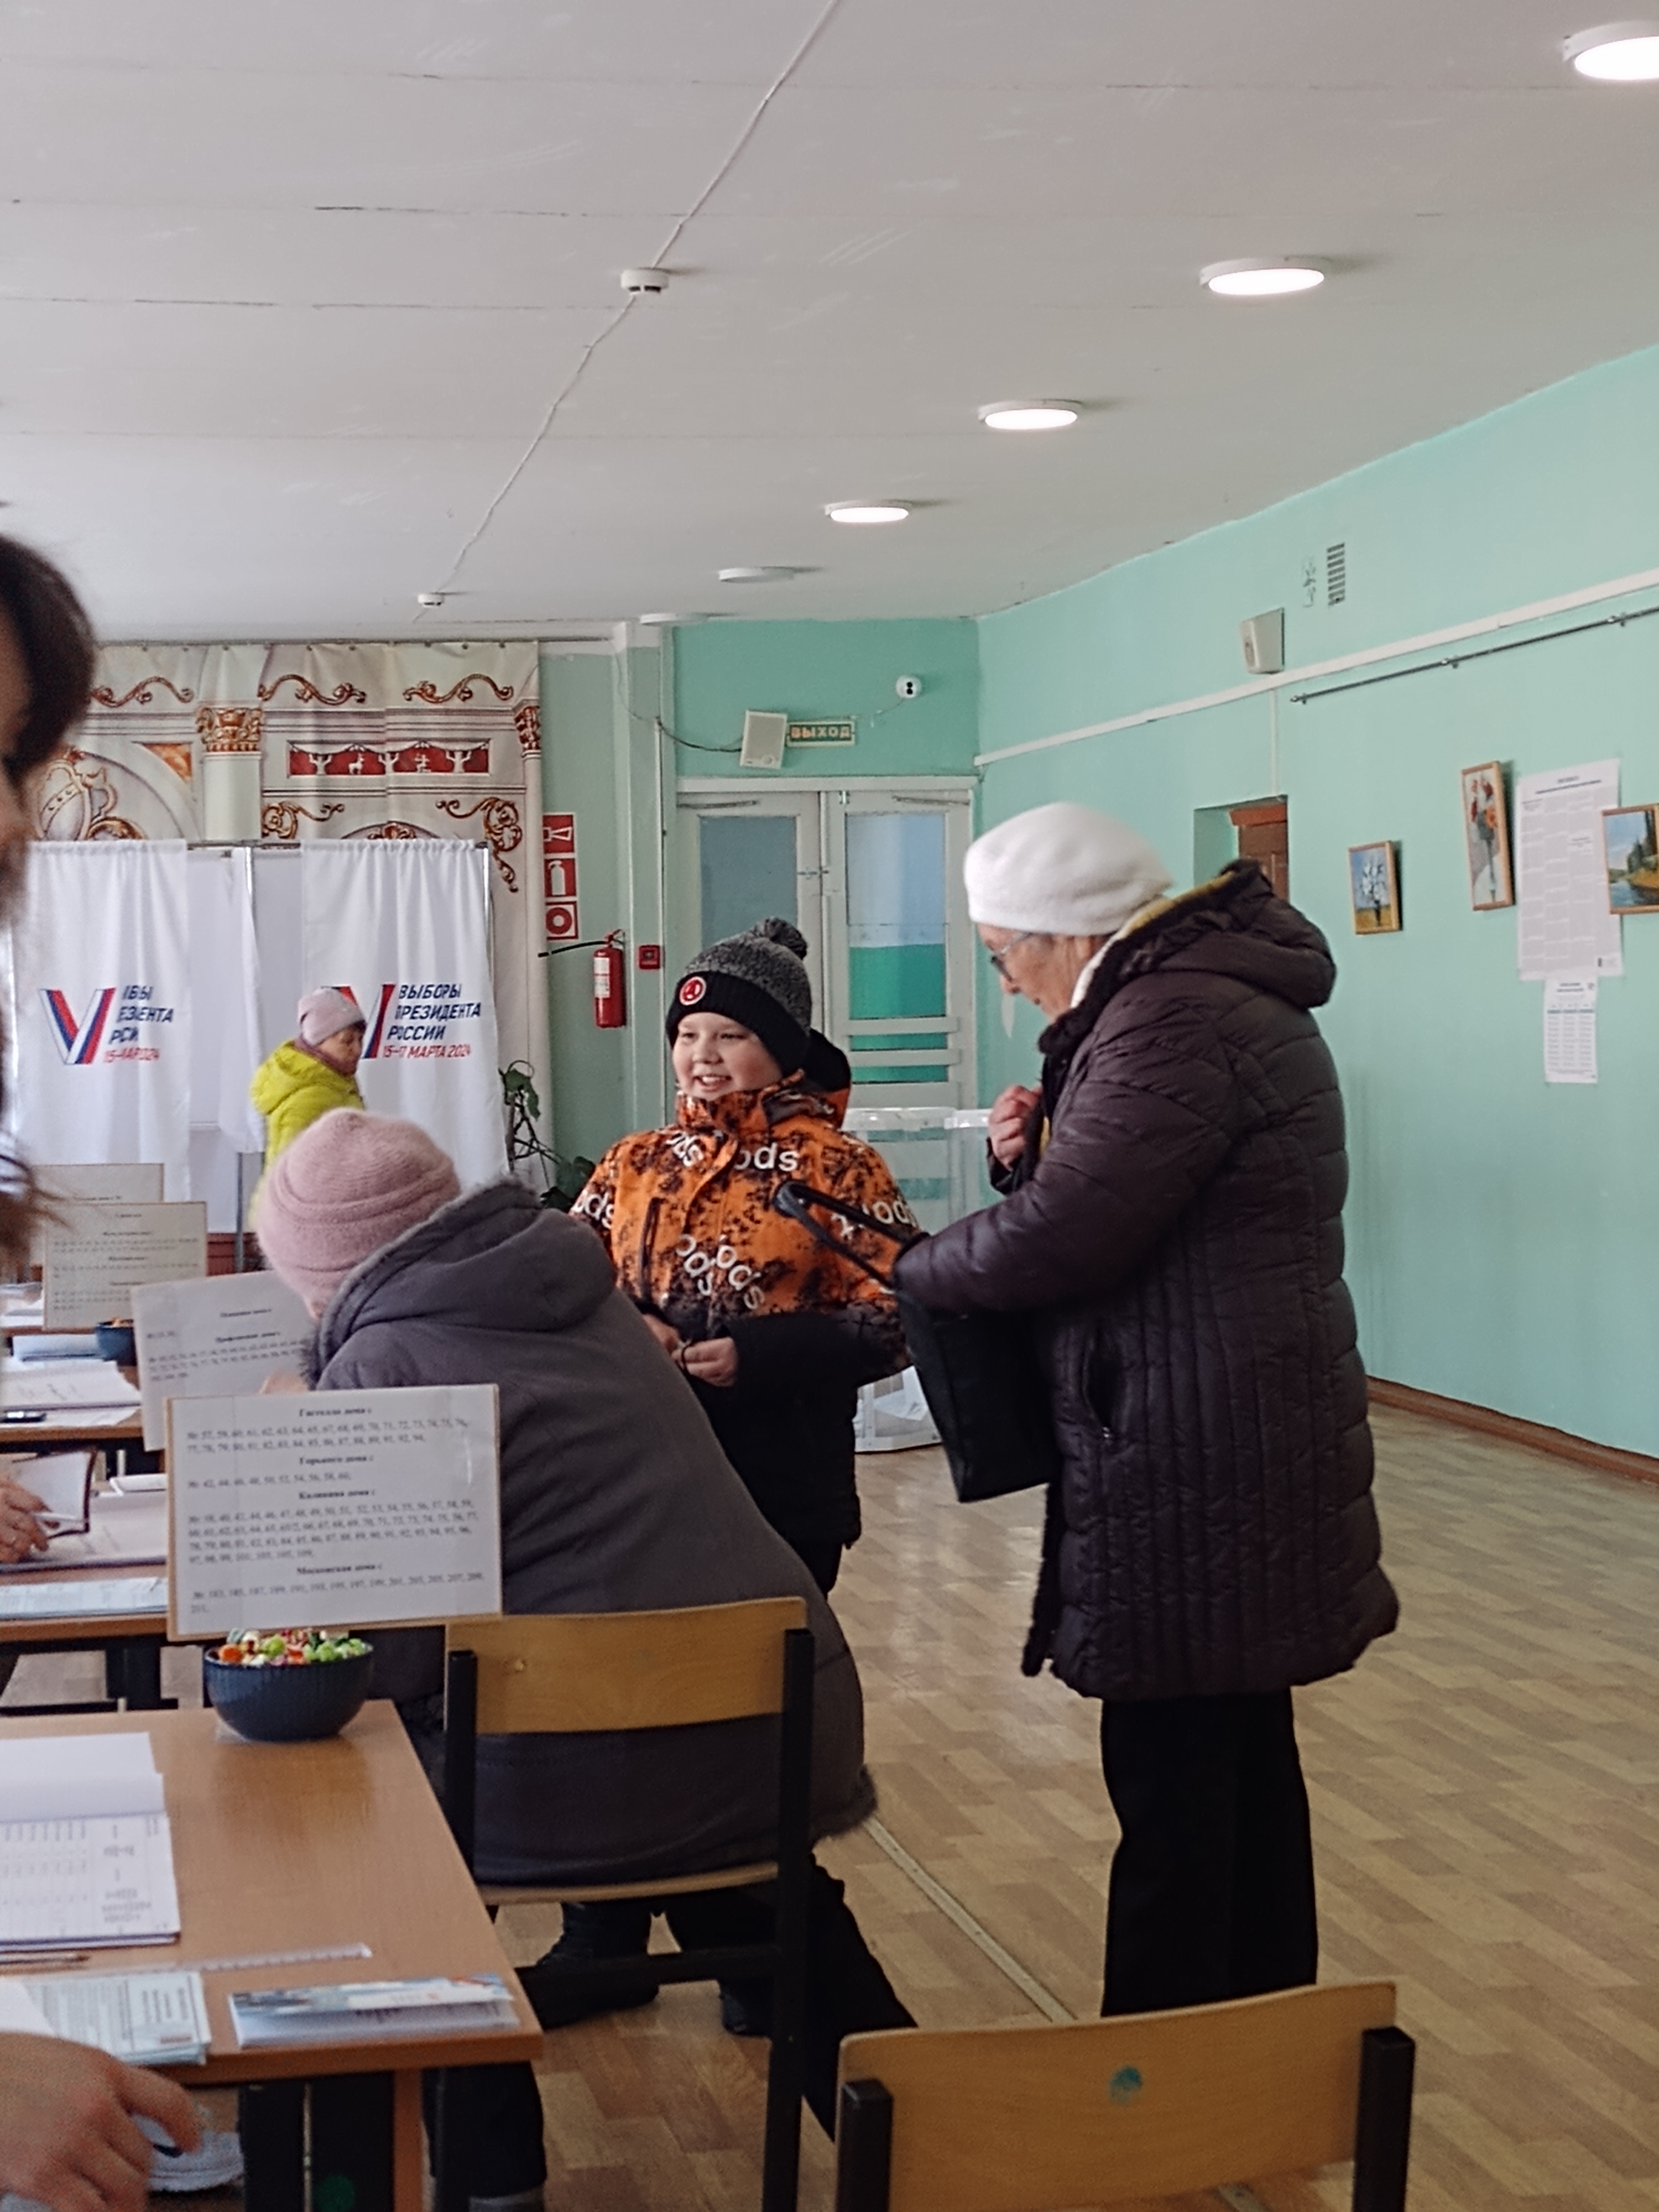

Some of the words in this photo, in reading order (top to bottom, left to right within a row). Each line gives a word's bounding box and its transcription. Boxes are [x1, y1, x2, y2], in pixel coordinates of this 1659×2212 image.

[791, 727, 850, 738] ВЫХОД
[398, 984, 462, 999] ВЫБОРЫ
[387, 1025, 447, 1040] РОССИИ
[408, 1044, 445, 1058] МАРТА
[447, 1044, 472, 1058] 2024
